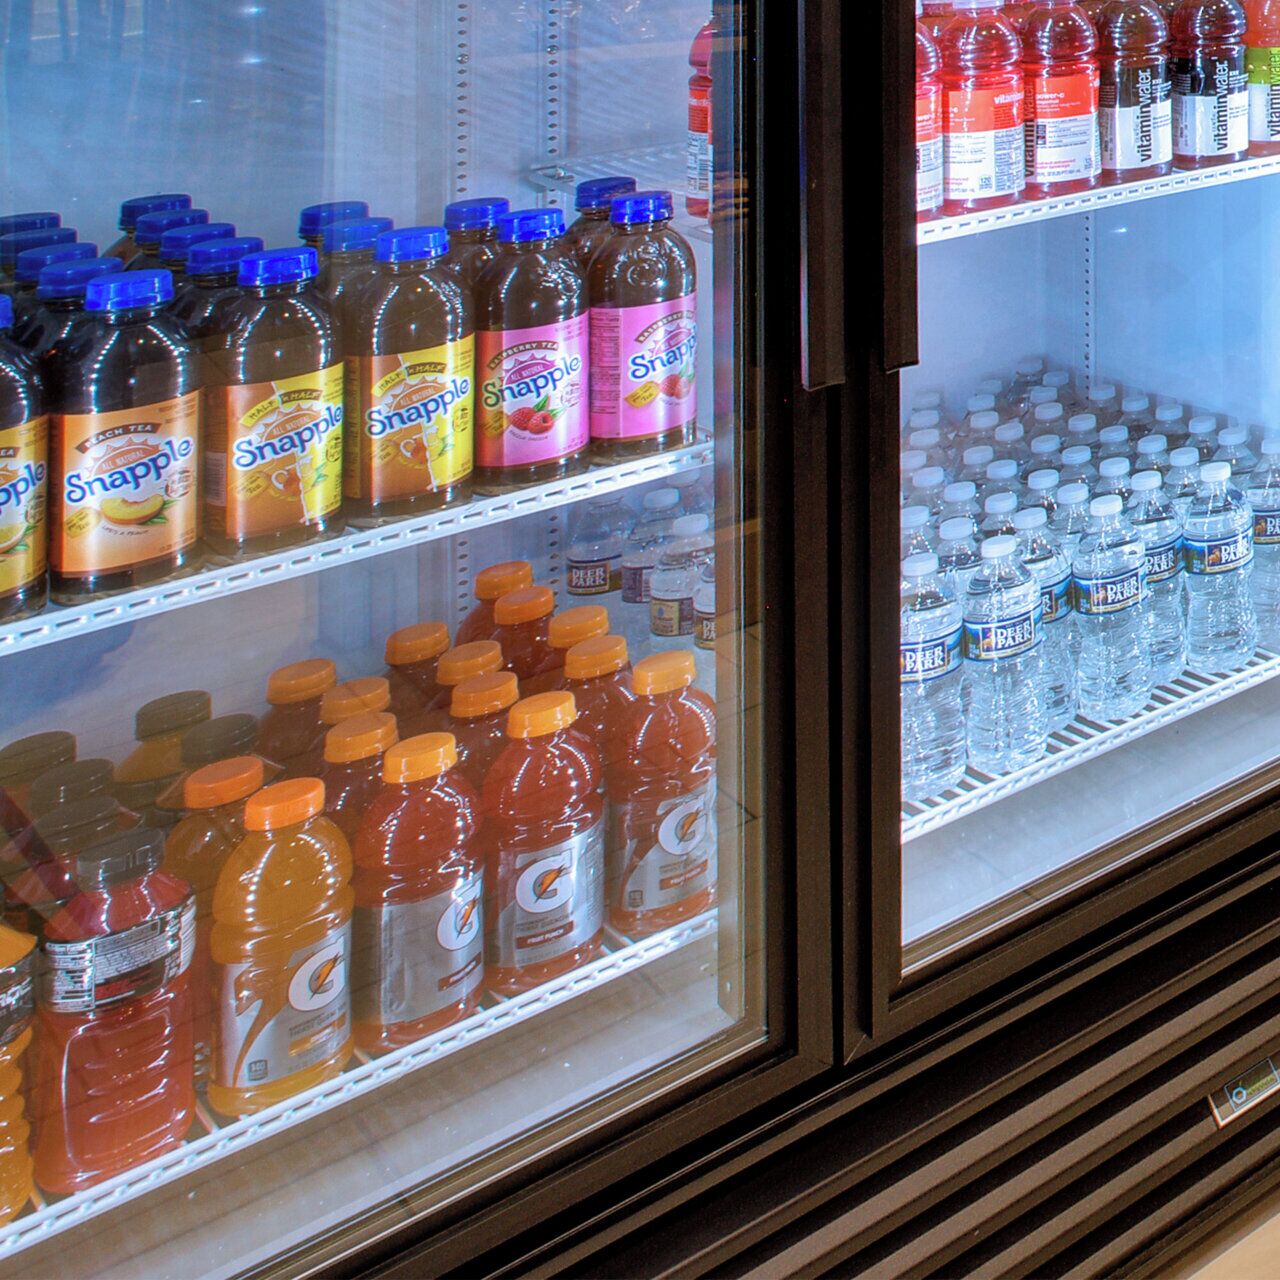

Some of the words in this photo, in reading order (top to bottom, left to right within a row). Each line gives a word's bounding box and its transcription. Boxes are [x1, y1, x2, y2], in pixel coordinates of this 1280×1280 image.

[542, 341, 559, 351] TEA
[482, 356, 582, 408] Snapple
[367, 377, 470, 437] Snapple
[130, 423, 153, 434] TEA
[235, 404, 343, 469] Snapple
[65, 438, 193, 504] Snapple
[572, 575, 605, 587] PARK
[573, 567, 604, 578] DEER
[1107, 576, 1138, 594] DEER
[1107, 586, 1139, 604] PARK
[997, 621, 1031, 639] DEER
[997, 631, 1032, 650] PARK
[906, 645, 943, 661] DEER
[905, 654, 944, 672] PARK
